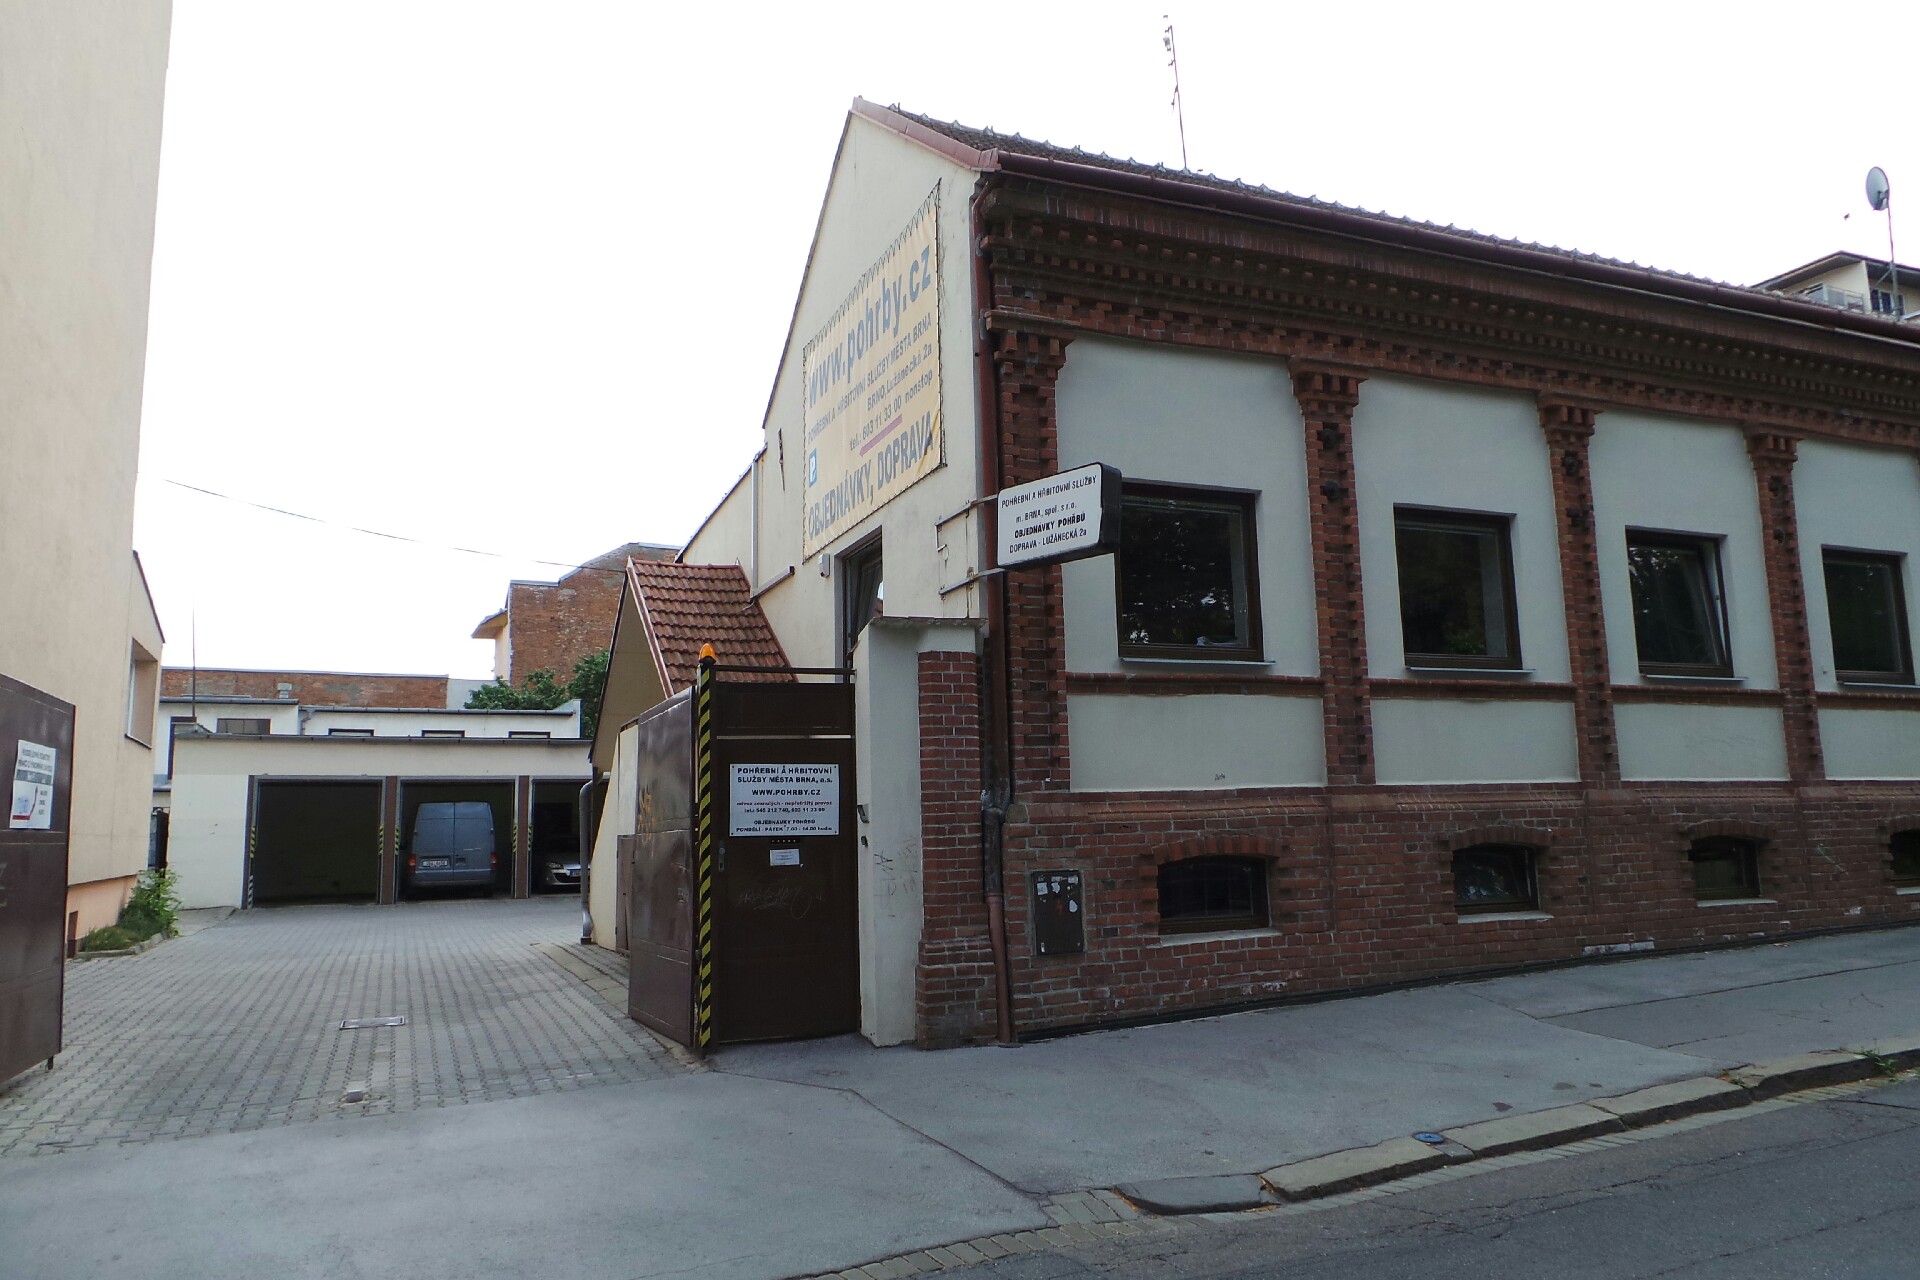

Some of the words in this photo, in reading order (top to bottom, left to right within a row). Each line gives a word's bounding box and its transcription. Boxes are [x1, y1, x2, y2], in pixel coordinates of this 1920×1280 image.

[808, 245, 931, 408] www.pohrby.cz
[891, 332, 912, 363] MĚSTA
[913, 312, 932, 342] BRNA
[923, 343, 932, 361] 2a
[863, 419, 874, 440] 603
[876, 410, 882, 427] 11
[884, 403, 892, 420] 33
[894, 394, 902, 412] 00
[905, 370, 933, 403] nonstop
[808, 459, 874, 540] OBJEDNÁVKY,
[877, 411, 933, 490] DOPRAVA
[1001, 492, 1031, 508] POHŘEBNÍ
[1032, 492, 1036, 500] A
[1037, 481, 1070, 499] HŘBITOVNÍ
[1071, 474, 1097, 489] SLUŽBY
[1009, 539, 1037, 553] DOPRAVA
[1042, 527, 1078, 546] LUŽÁNECKÁ
[1079, 528, 1087, 537] 2a
[1014, 520, 1055, 539] OBJEDNÁVKY
[1057, 510, 1086, 528] POHŘBŮ
[737, 775, 767, 783] SLUŽBY
[769, 775, 795, 783] MĚSTA
